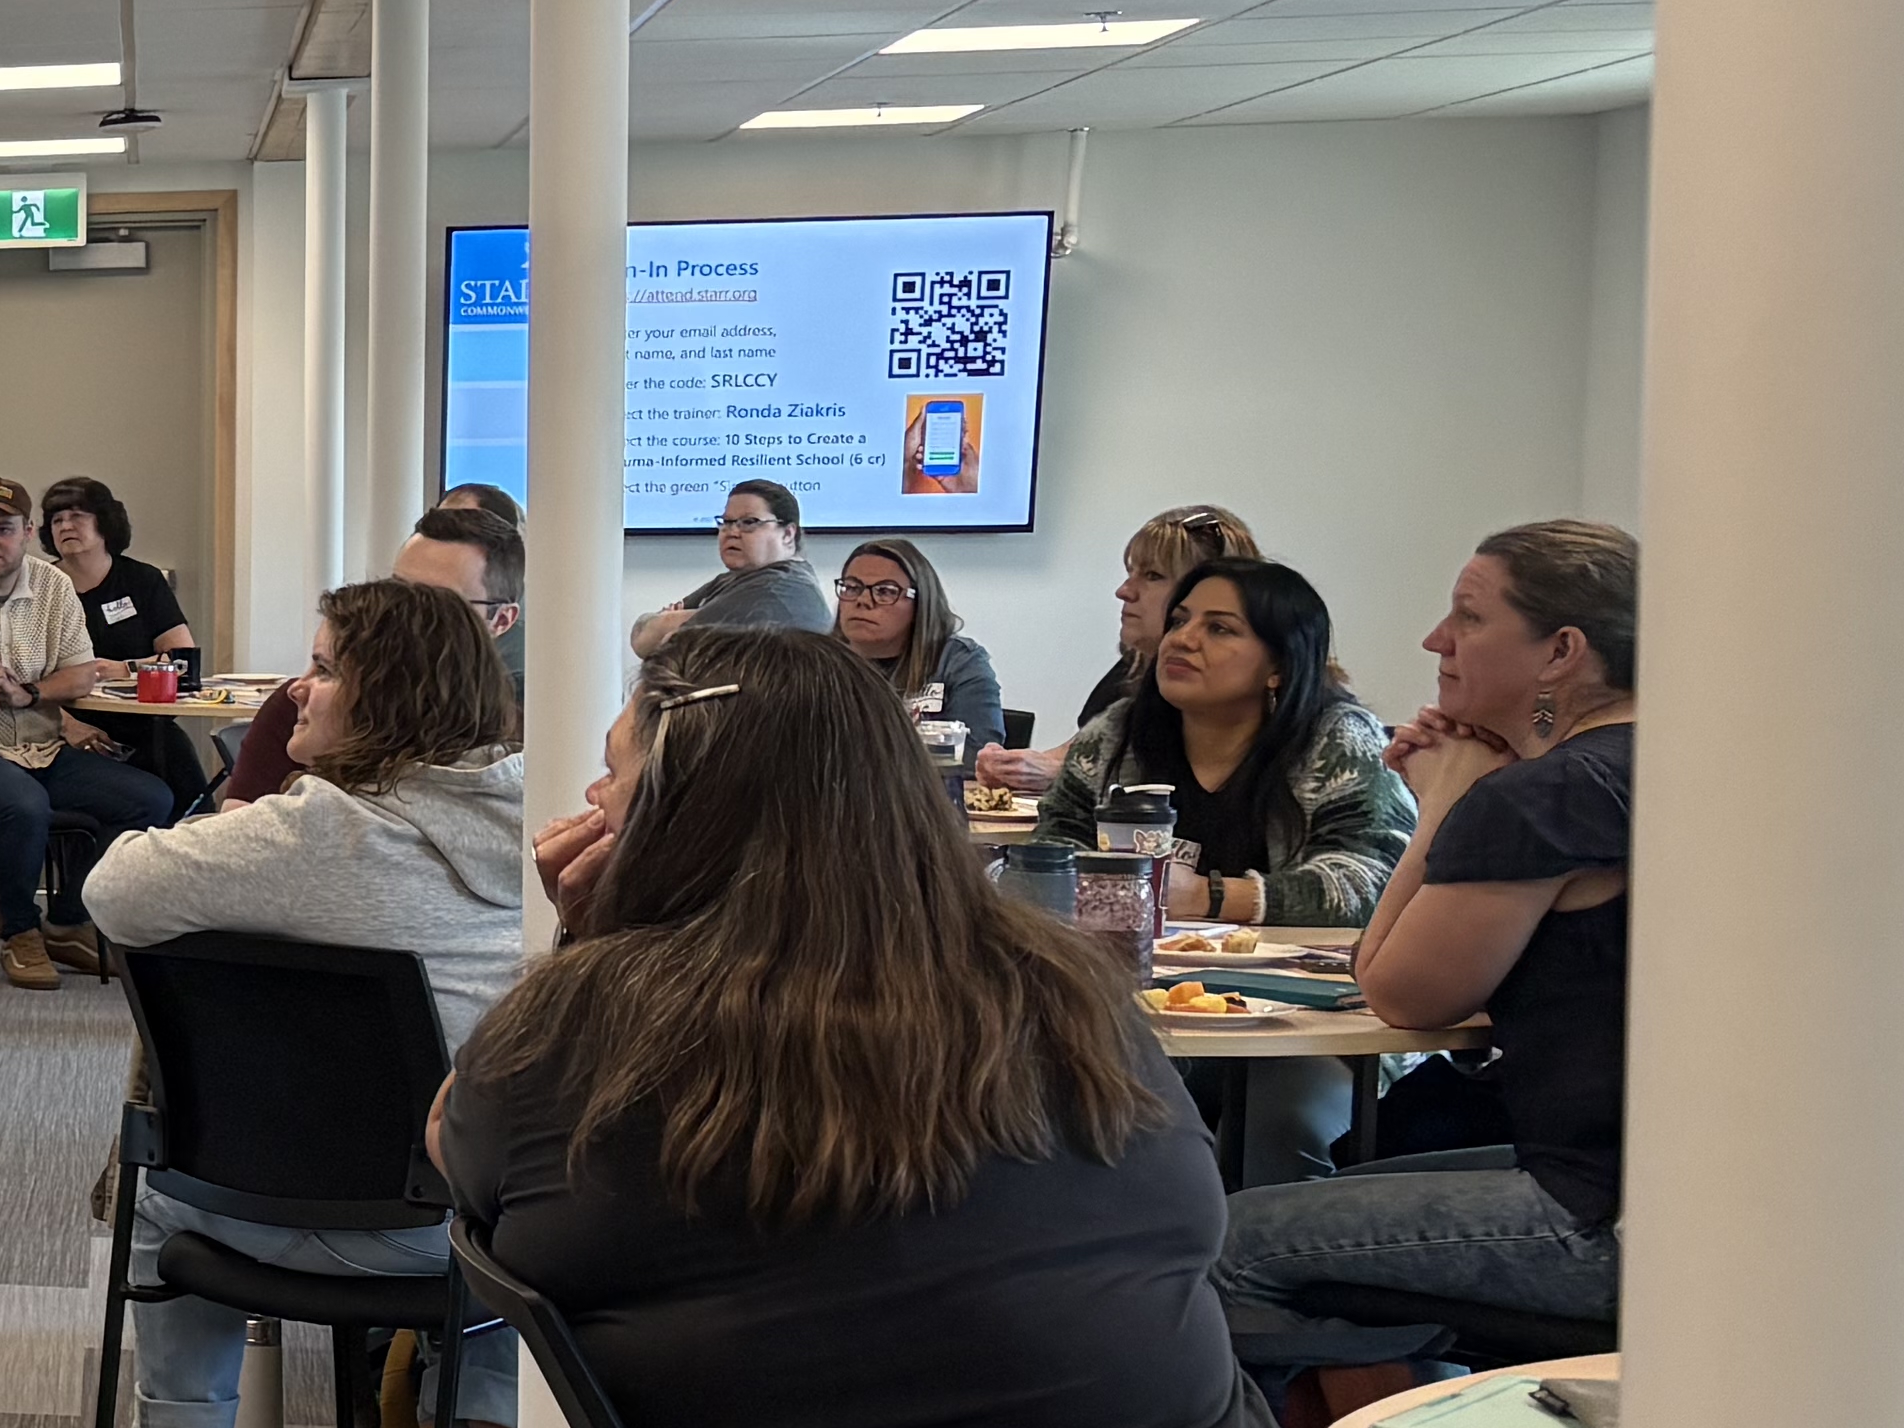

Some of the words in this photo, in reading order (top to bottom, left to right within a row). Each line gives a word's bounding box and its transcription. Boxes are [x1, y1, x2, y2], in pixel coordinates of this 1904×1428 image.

[677, 259, 759, 277] Process
[644, 328, 675, 342] your
[679, 325, 717, 338] email
[720, 324, 777, 339] address,
[634, 348, 676, 361] name,
[680, 346, 706, 360] and
[710, 346, 733, 359] last
[737, 347, 777, 359] name
[643, 377, 665, 389] the
[669, 377, 706, 389] code:
[711, 373, 778, 388] SRLCCY
[647, 408, 669, 420] the
[673, 408, 721, 420] trainer:
[726, 404, 782, 419] Ronda
[787, 403, 846, 418] Ziakris
[646, 435, 668, 447] the
[672, 436, 721, 447] course:
[725, 434, 740, 446] 10
[744, 433, 783, 448] Steps
[788, 434, 803, 446] to
[807, 433, 854, 446] Create
[858, 435, 867, 445] a
[731, 454, 792, 467] Resilient
[796, 453, 844, 466] School
[849, 453, 863, 467] (6
[867, 453, 886, 467] cr)
[644, 480, 666, 493] the
[670, 482, 709, 496] green
[786, 481, 821, 491] utton
